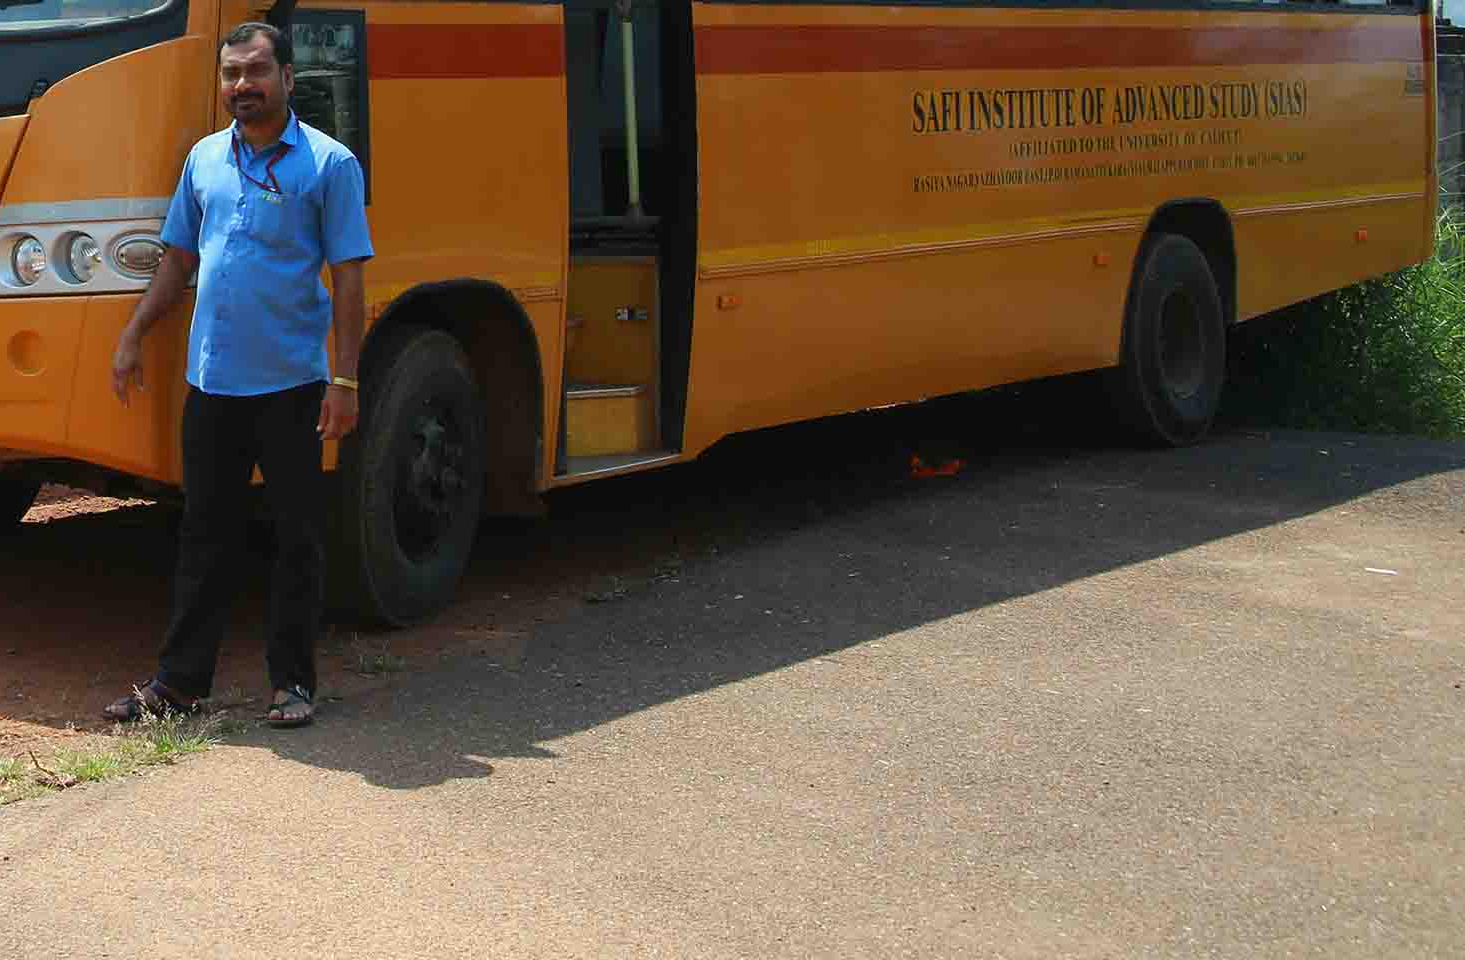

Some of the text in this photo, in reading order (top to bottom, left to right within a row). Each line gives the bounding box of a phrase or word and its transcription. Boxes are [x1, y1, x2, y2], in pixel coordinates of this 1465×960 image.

[912, 79, 1308, 134] SAFI INSTITUTE OF ADVANCED STUDY (SIAS)
